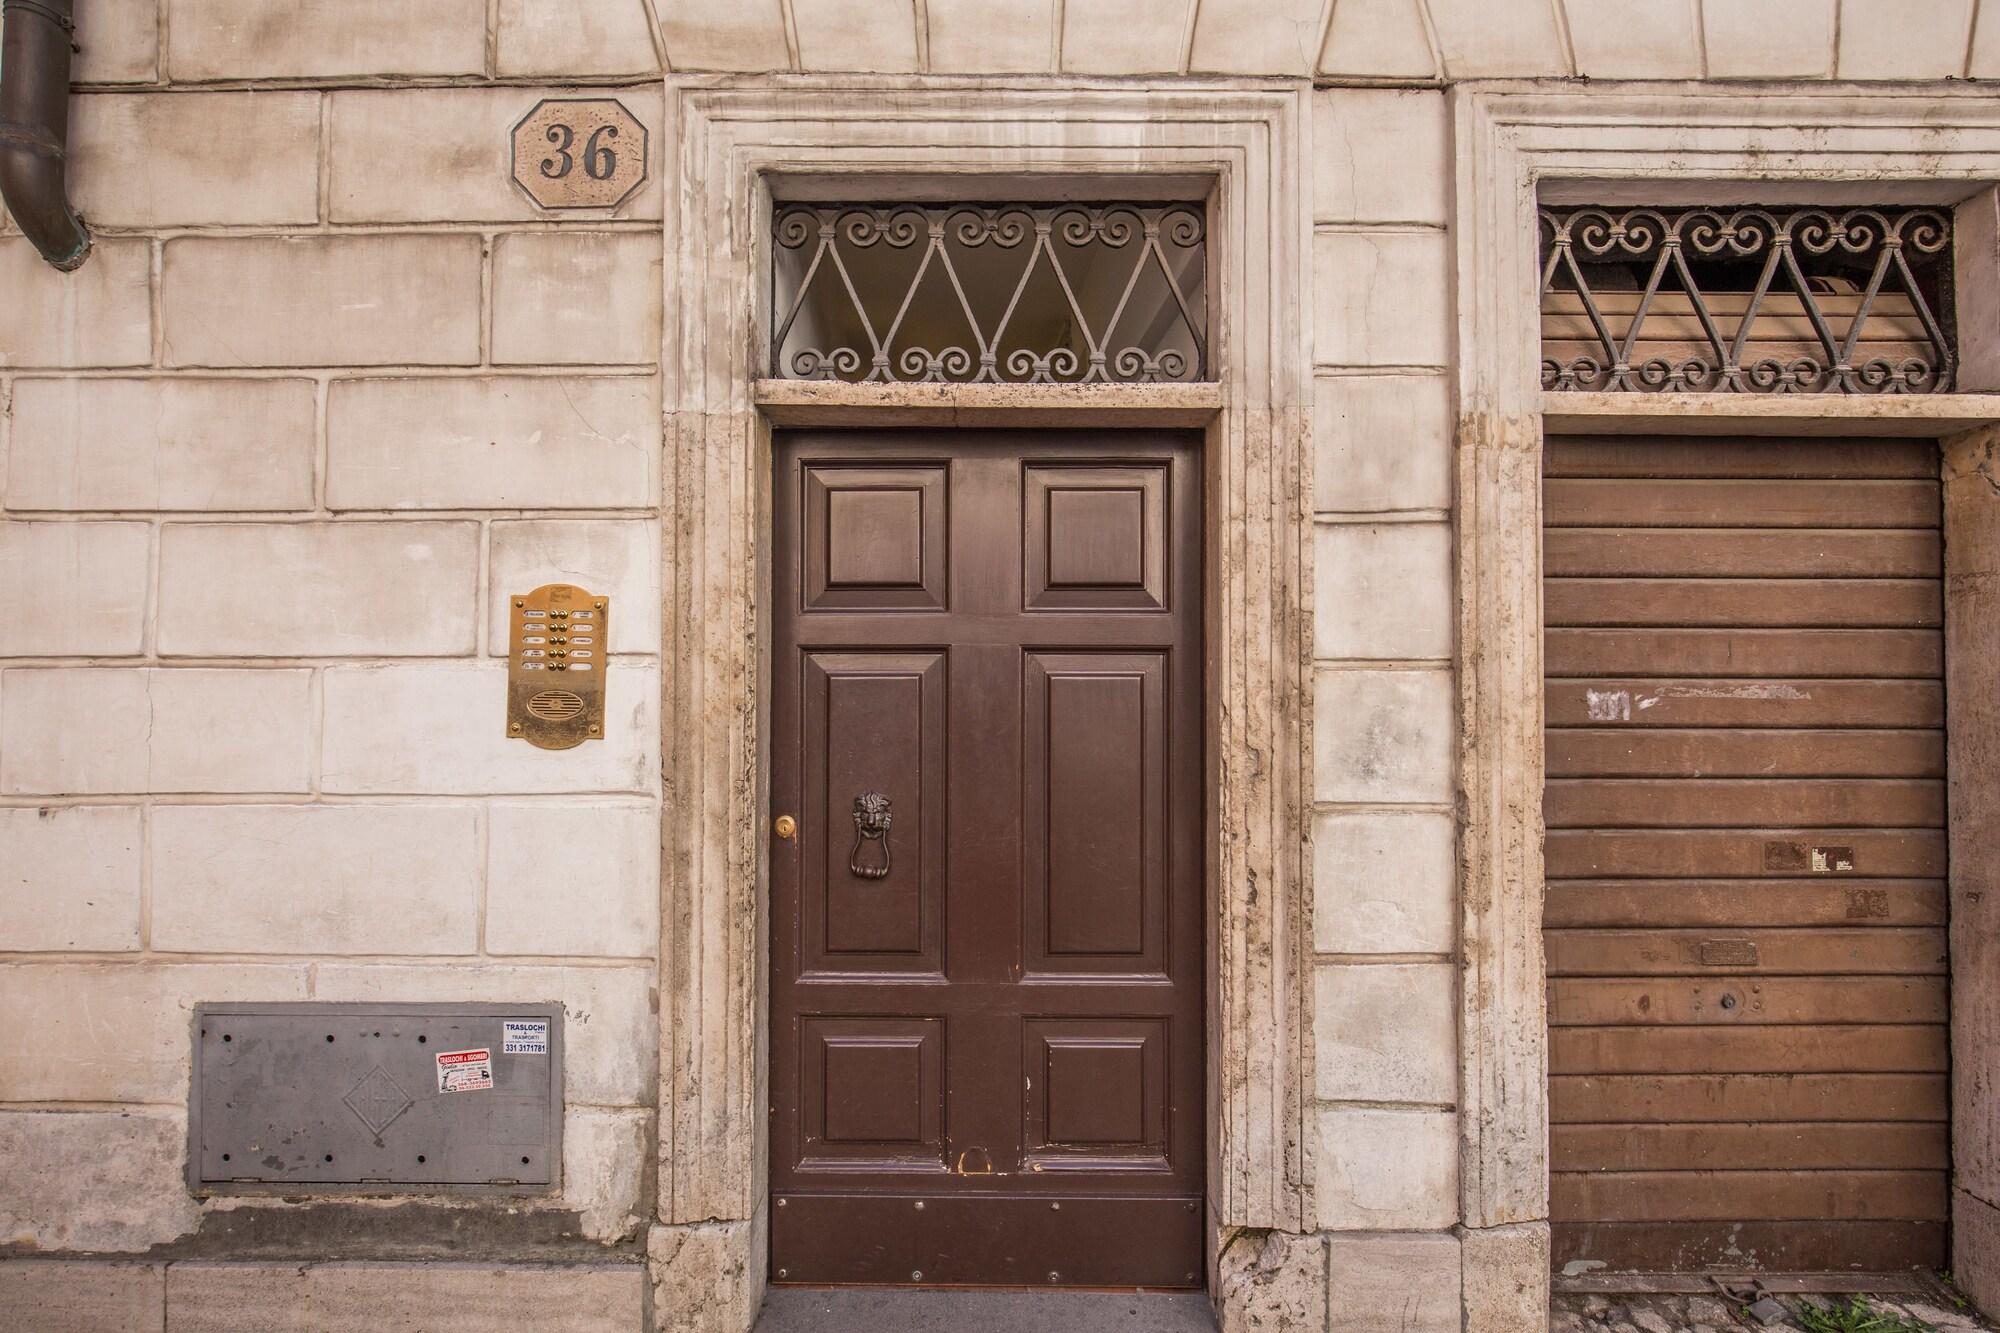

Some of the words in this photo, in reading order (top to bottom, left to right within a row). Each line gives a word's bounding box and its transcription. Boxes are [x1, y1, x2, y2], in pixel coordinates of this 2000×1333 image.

[540, 123, 619, 180] 36
[505, 1044, 517, 1052] 331
[518, 1044, 545, 1052] 3171781
[440, 1055, 463, 1063] TRASLOCHI
